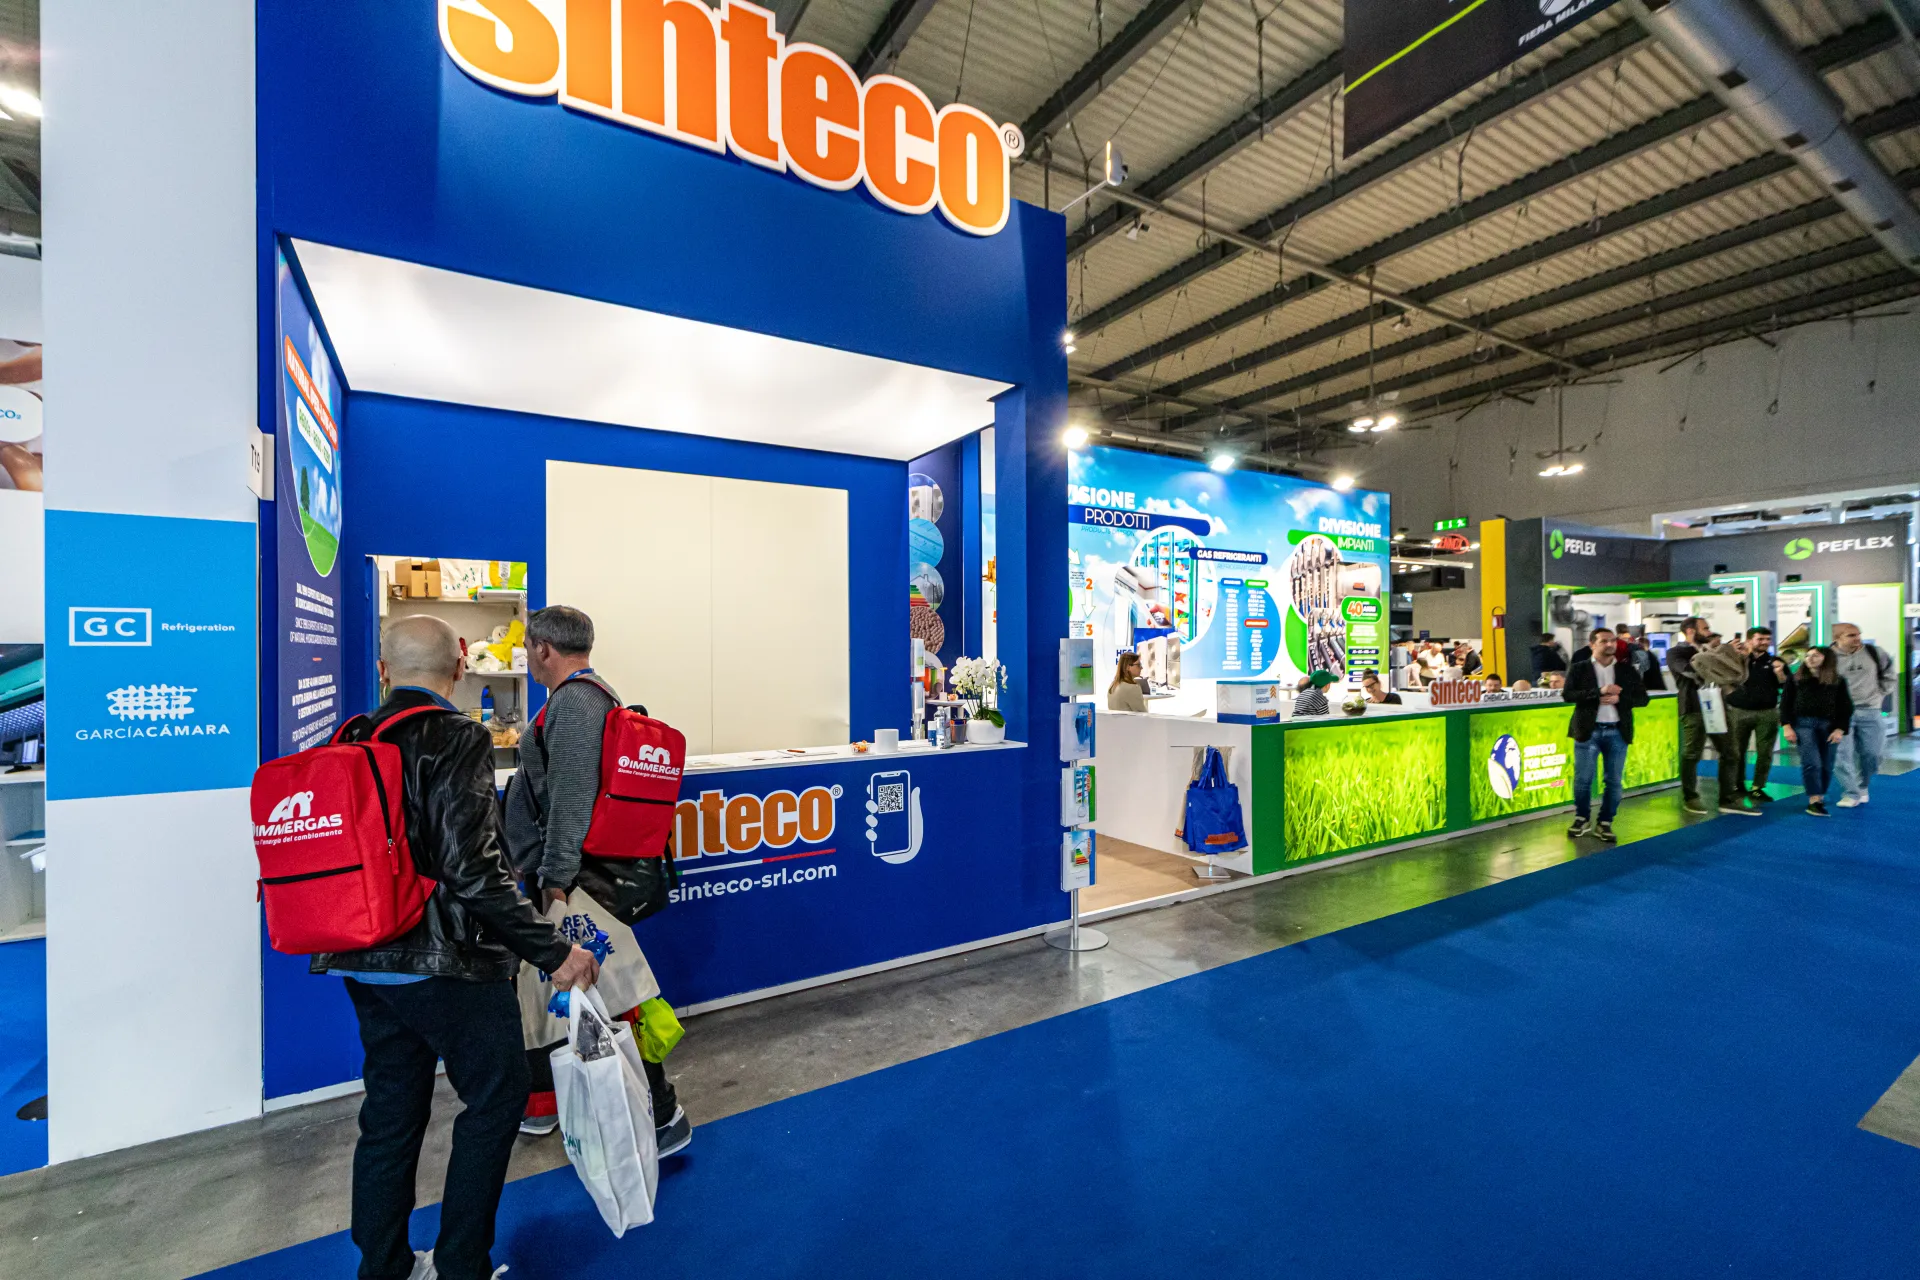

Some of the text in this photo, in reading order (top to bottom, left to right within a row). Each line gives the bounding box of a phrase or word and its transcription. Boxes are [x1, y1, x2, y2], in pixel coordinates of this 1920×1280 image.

[1518, 19, 1554, 47] FIERA
[250, 443, 261, 474] T19
[1085, 508, 1150, 529] PRODOTTI
[1319, 517, 1382, 538] DIVISIONE
[1337, 537, 1375, 552] IMPIANTI
[1565, 538, 1597, 556] PEFLEX
[1817, 535, 1895, 554] PEFLEX
[1197, 549, 1262, 563] GAS REFRIGERANTI
[1085, 578, 1093, 590] 2
[1348, 601, 1363, 616] 40
[83, 617, 137, 638] GC
[161, 622, 236, 633] Refrigeration
[1085, 624, 1094, 636] 3
[1430, 678, 1482, 707] sinteco
[76, 722, 231, 741] GARCÍACÁMARA
[1524, 743, 1557, 757] SINTECO
[629, 760, 681, 776] IMMERGAS
[1524, 754, 1567, 770] FOR GREEN
[1524, 766, 1563, 783] ECONOMY
[256, 813, 343, 837] IMMERGAS
[260, 837, 282, 846] l'energia
[282, 835, 293, 843] del
[294, 829, 343, 842] cambiamento
[668, 864, 837, 904] sinteco-srl.com
